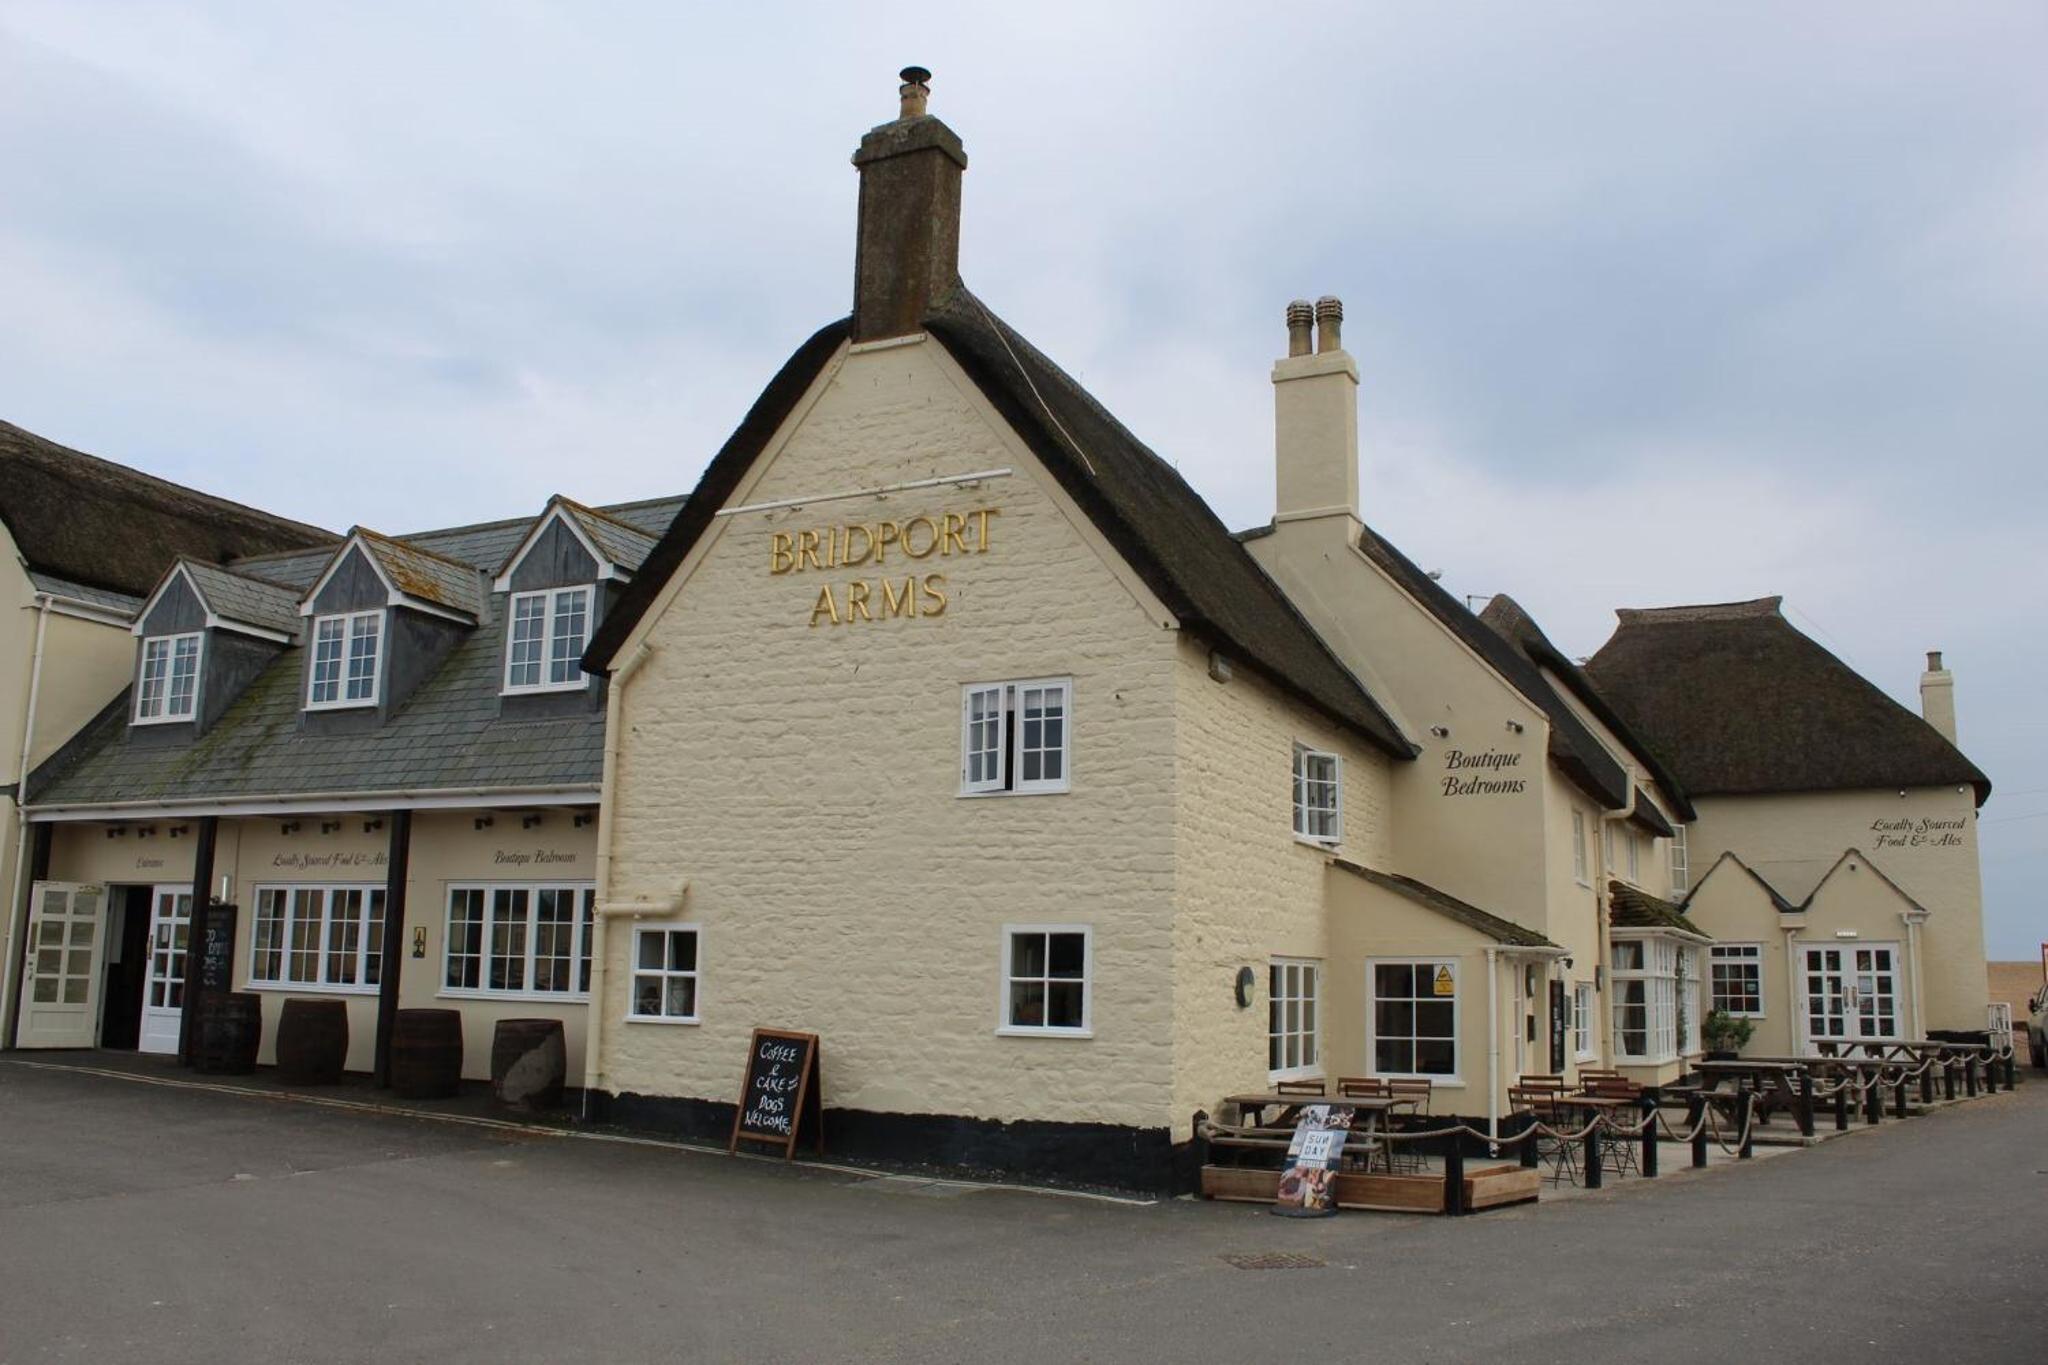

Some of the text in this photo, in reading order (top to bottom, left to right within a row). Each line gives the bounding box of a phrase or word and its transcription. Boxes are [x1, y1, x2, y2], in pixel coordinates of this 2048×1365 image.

[770, 508, 999, 575] BRIDPORT
[808, 574, 948, 627] ARMS
[1444, 748, 1522, 771] Boutique
[1442, 776, 1527, 797] Bedrooms
[1870, 816, 1967, 834] Locally Sourced
[1872, 832, 1962, 852] Food & Ales
